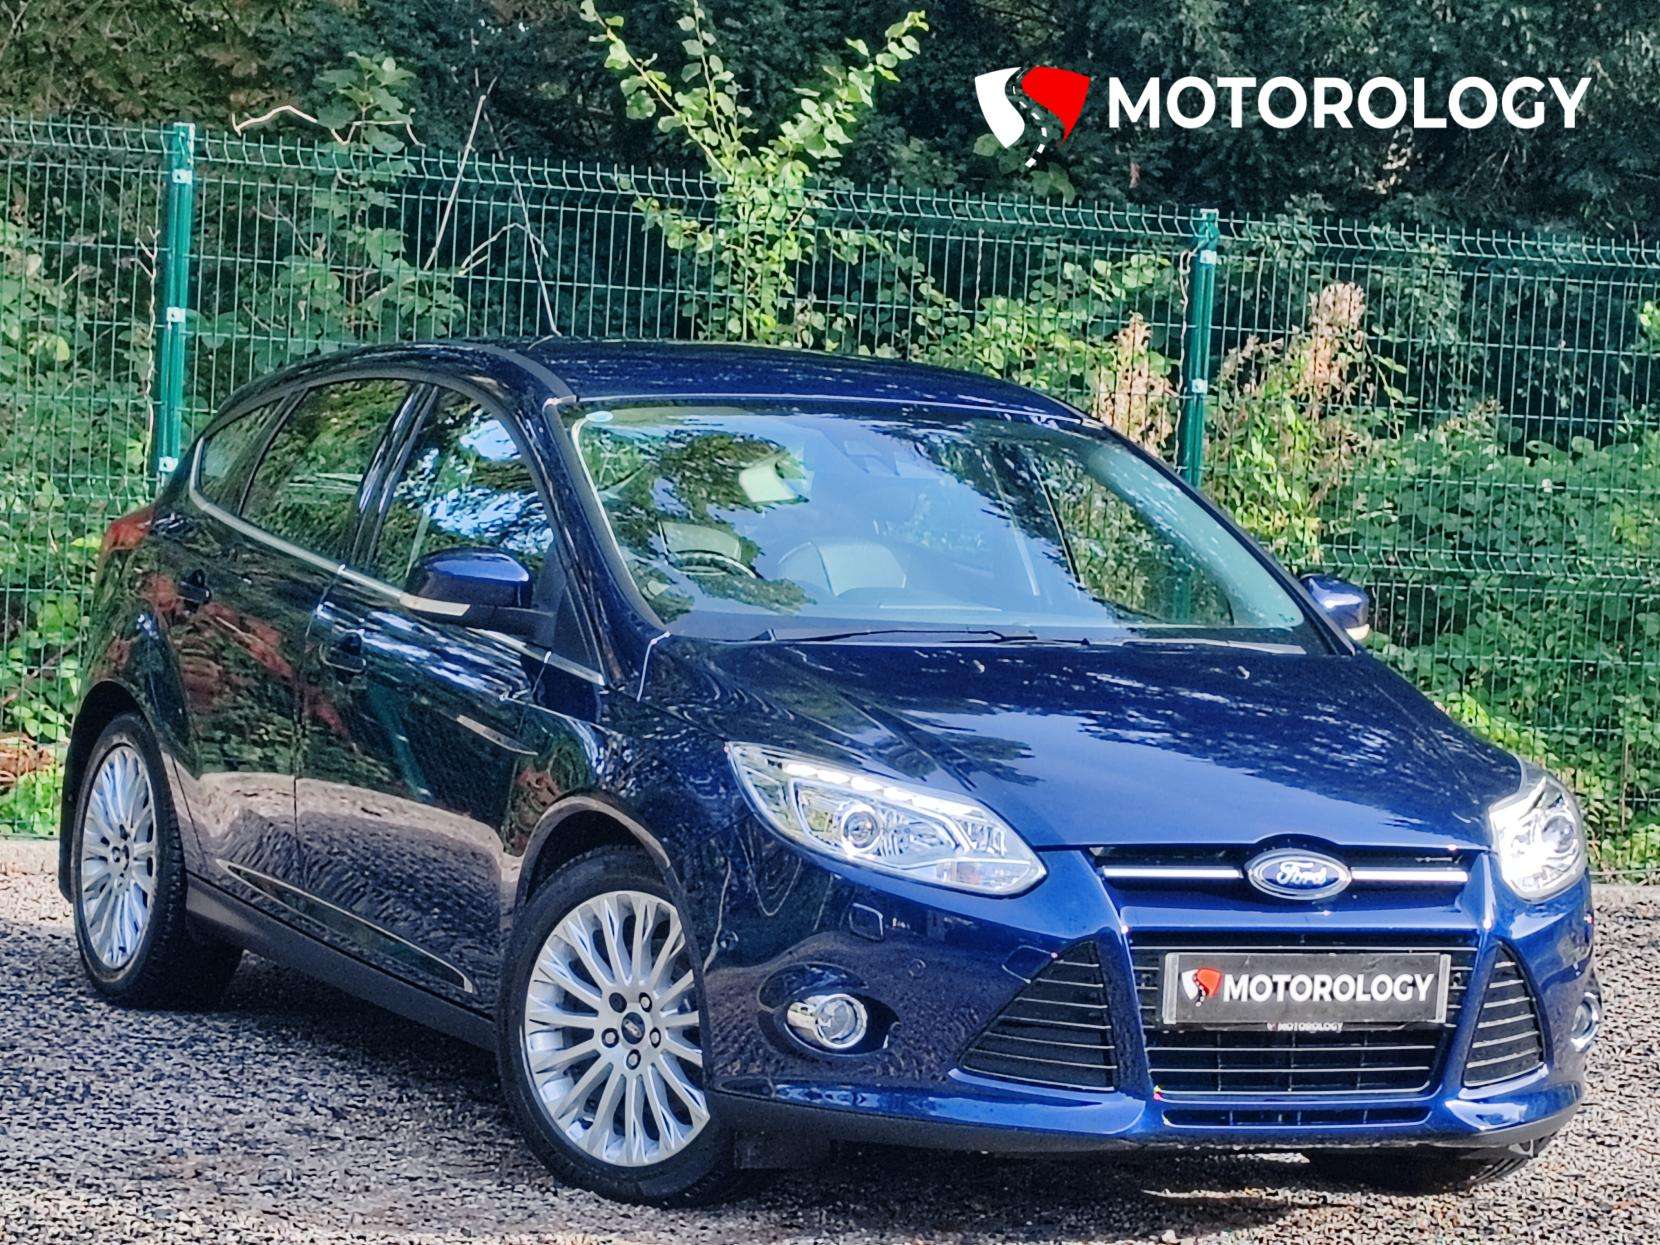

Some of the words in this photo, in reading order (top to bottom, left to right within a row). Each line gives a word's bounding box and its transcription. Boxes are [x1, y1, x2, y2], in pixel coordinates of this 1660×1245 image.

[1276, 861, 1328, 886] Ford
[1222, 973, 1435, 1002] MOTOROLOGY
[1277, 1021, 1344, 1032] MOTOROLOGY
